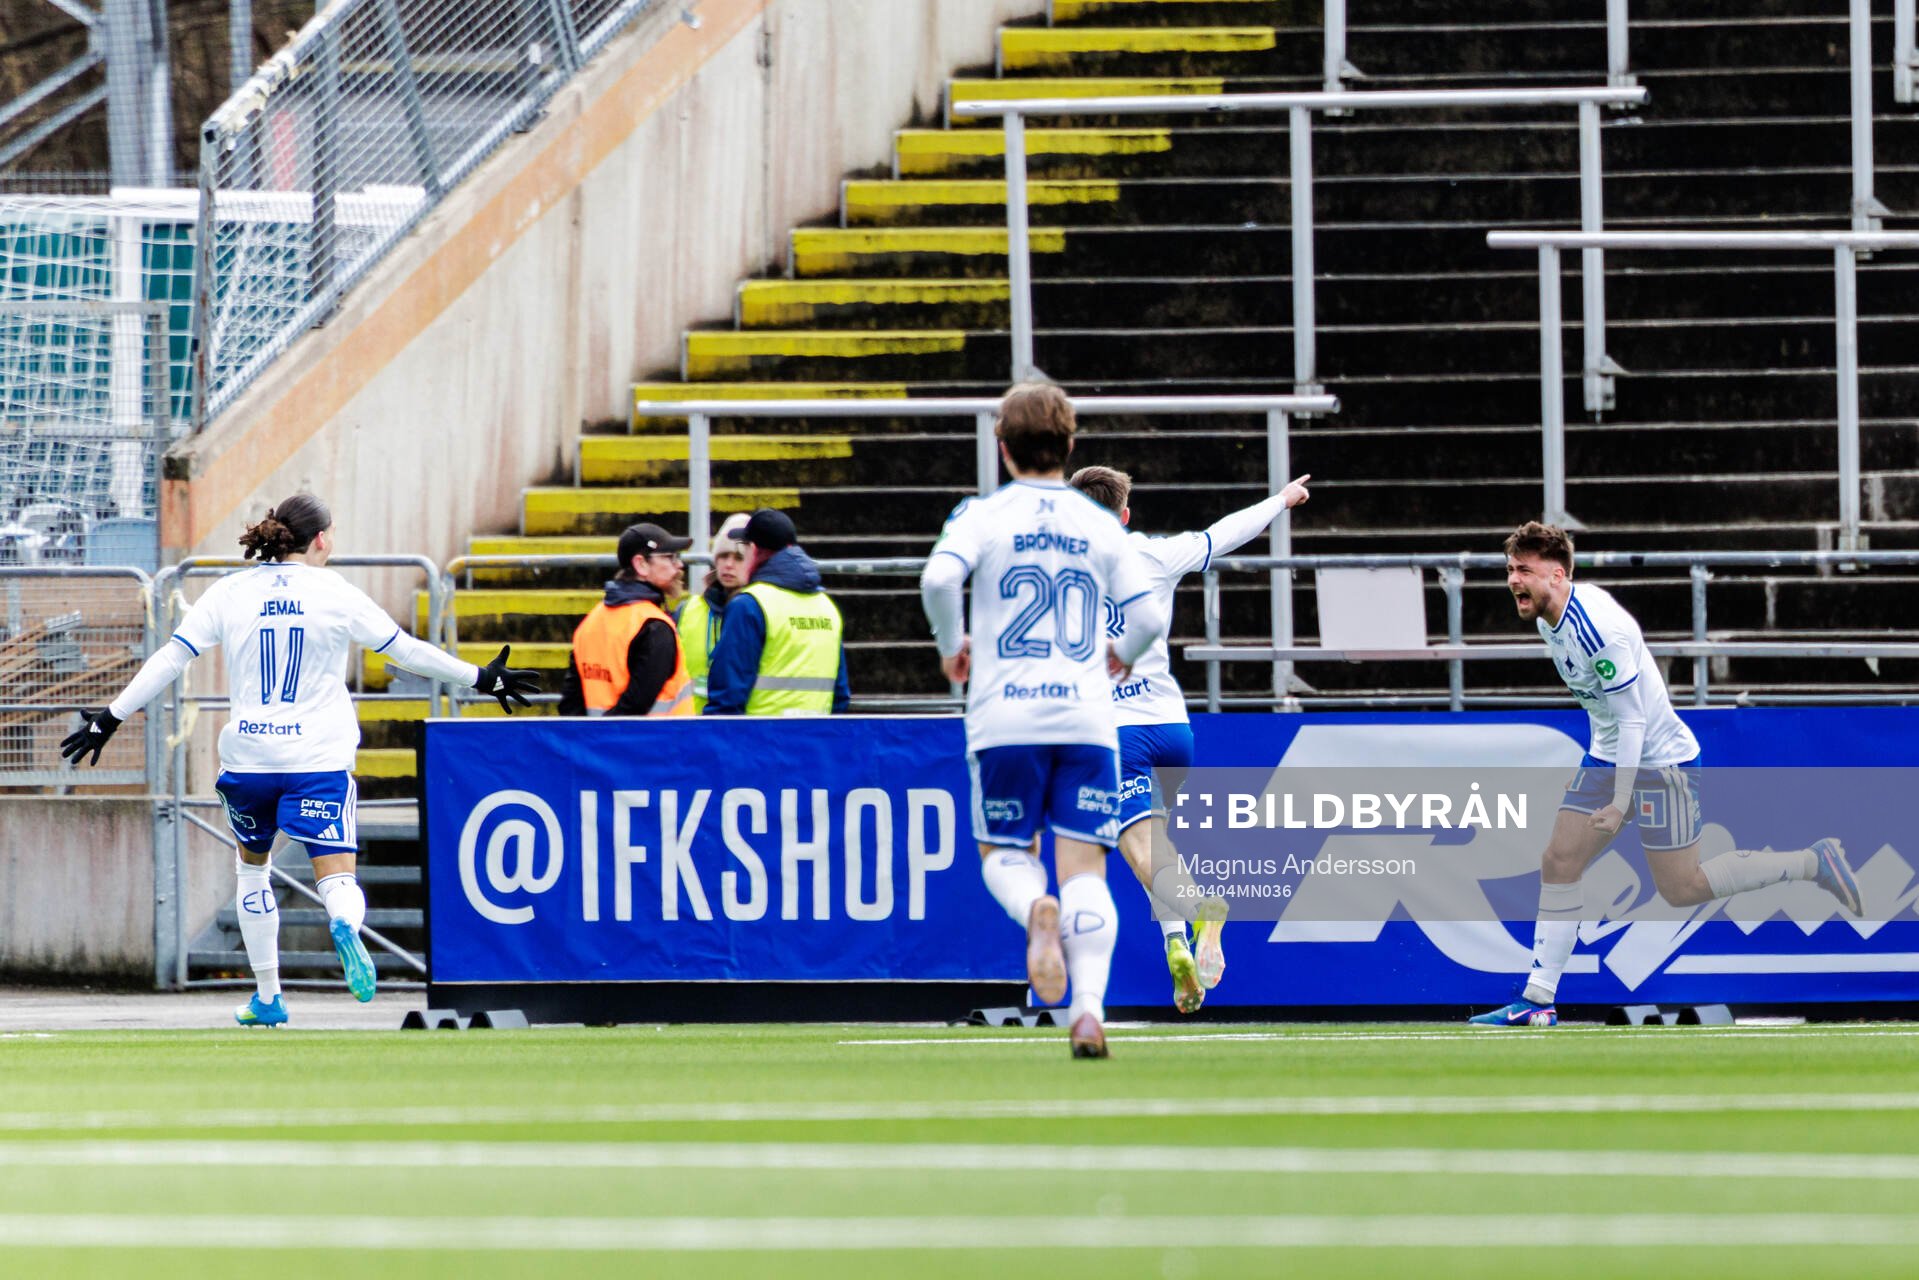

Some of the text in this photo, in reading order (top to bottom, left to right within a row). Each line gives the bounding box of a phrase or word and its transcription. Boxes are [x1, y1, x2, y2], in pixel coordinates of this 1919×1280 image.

[1013, 528, 1090, 555] BRÖNNER
[259, 600, 305, 617] JEMAL
[998, 565, 1099, 662] 20
[259, 627, 305, 705] 11
[1003, 682, 1081, 700] Reztart
[238, 719, 303, 736] Reztart
[1078, 786, 1106, 801] pre
[300, 799, 323, 809] pre
[1077, 799, 1112, 815] zero
[300, 808, 331, 819] zero
[458, 787, 956, 925] @IFKSHOP
